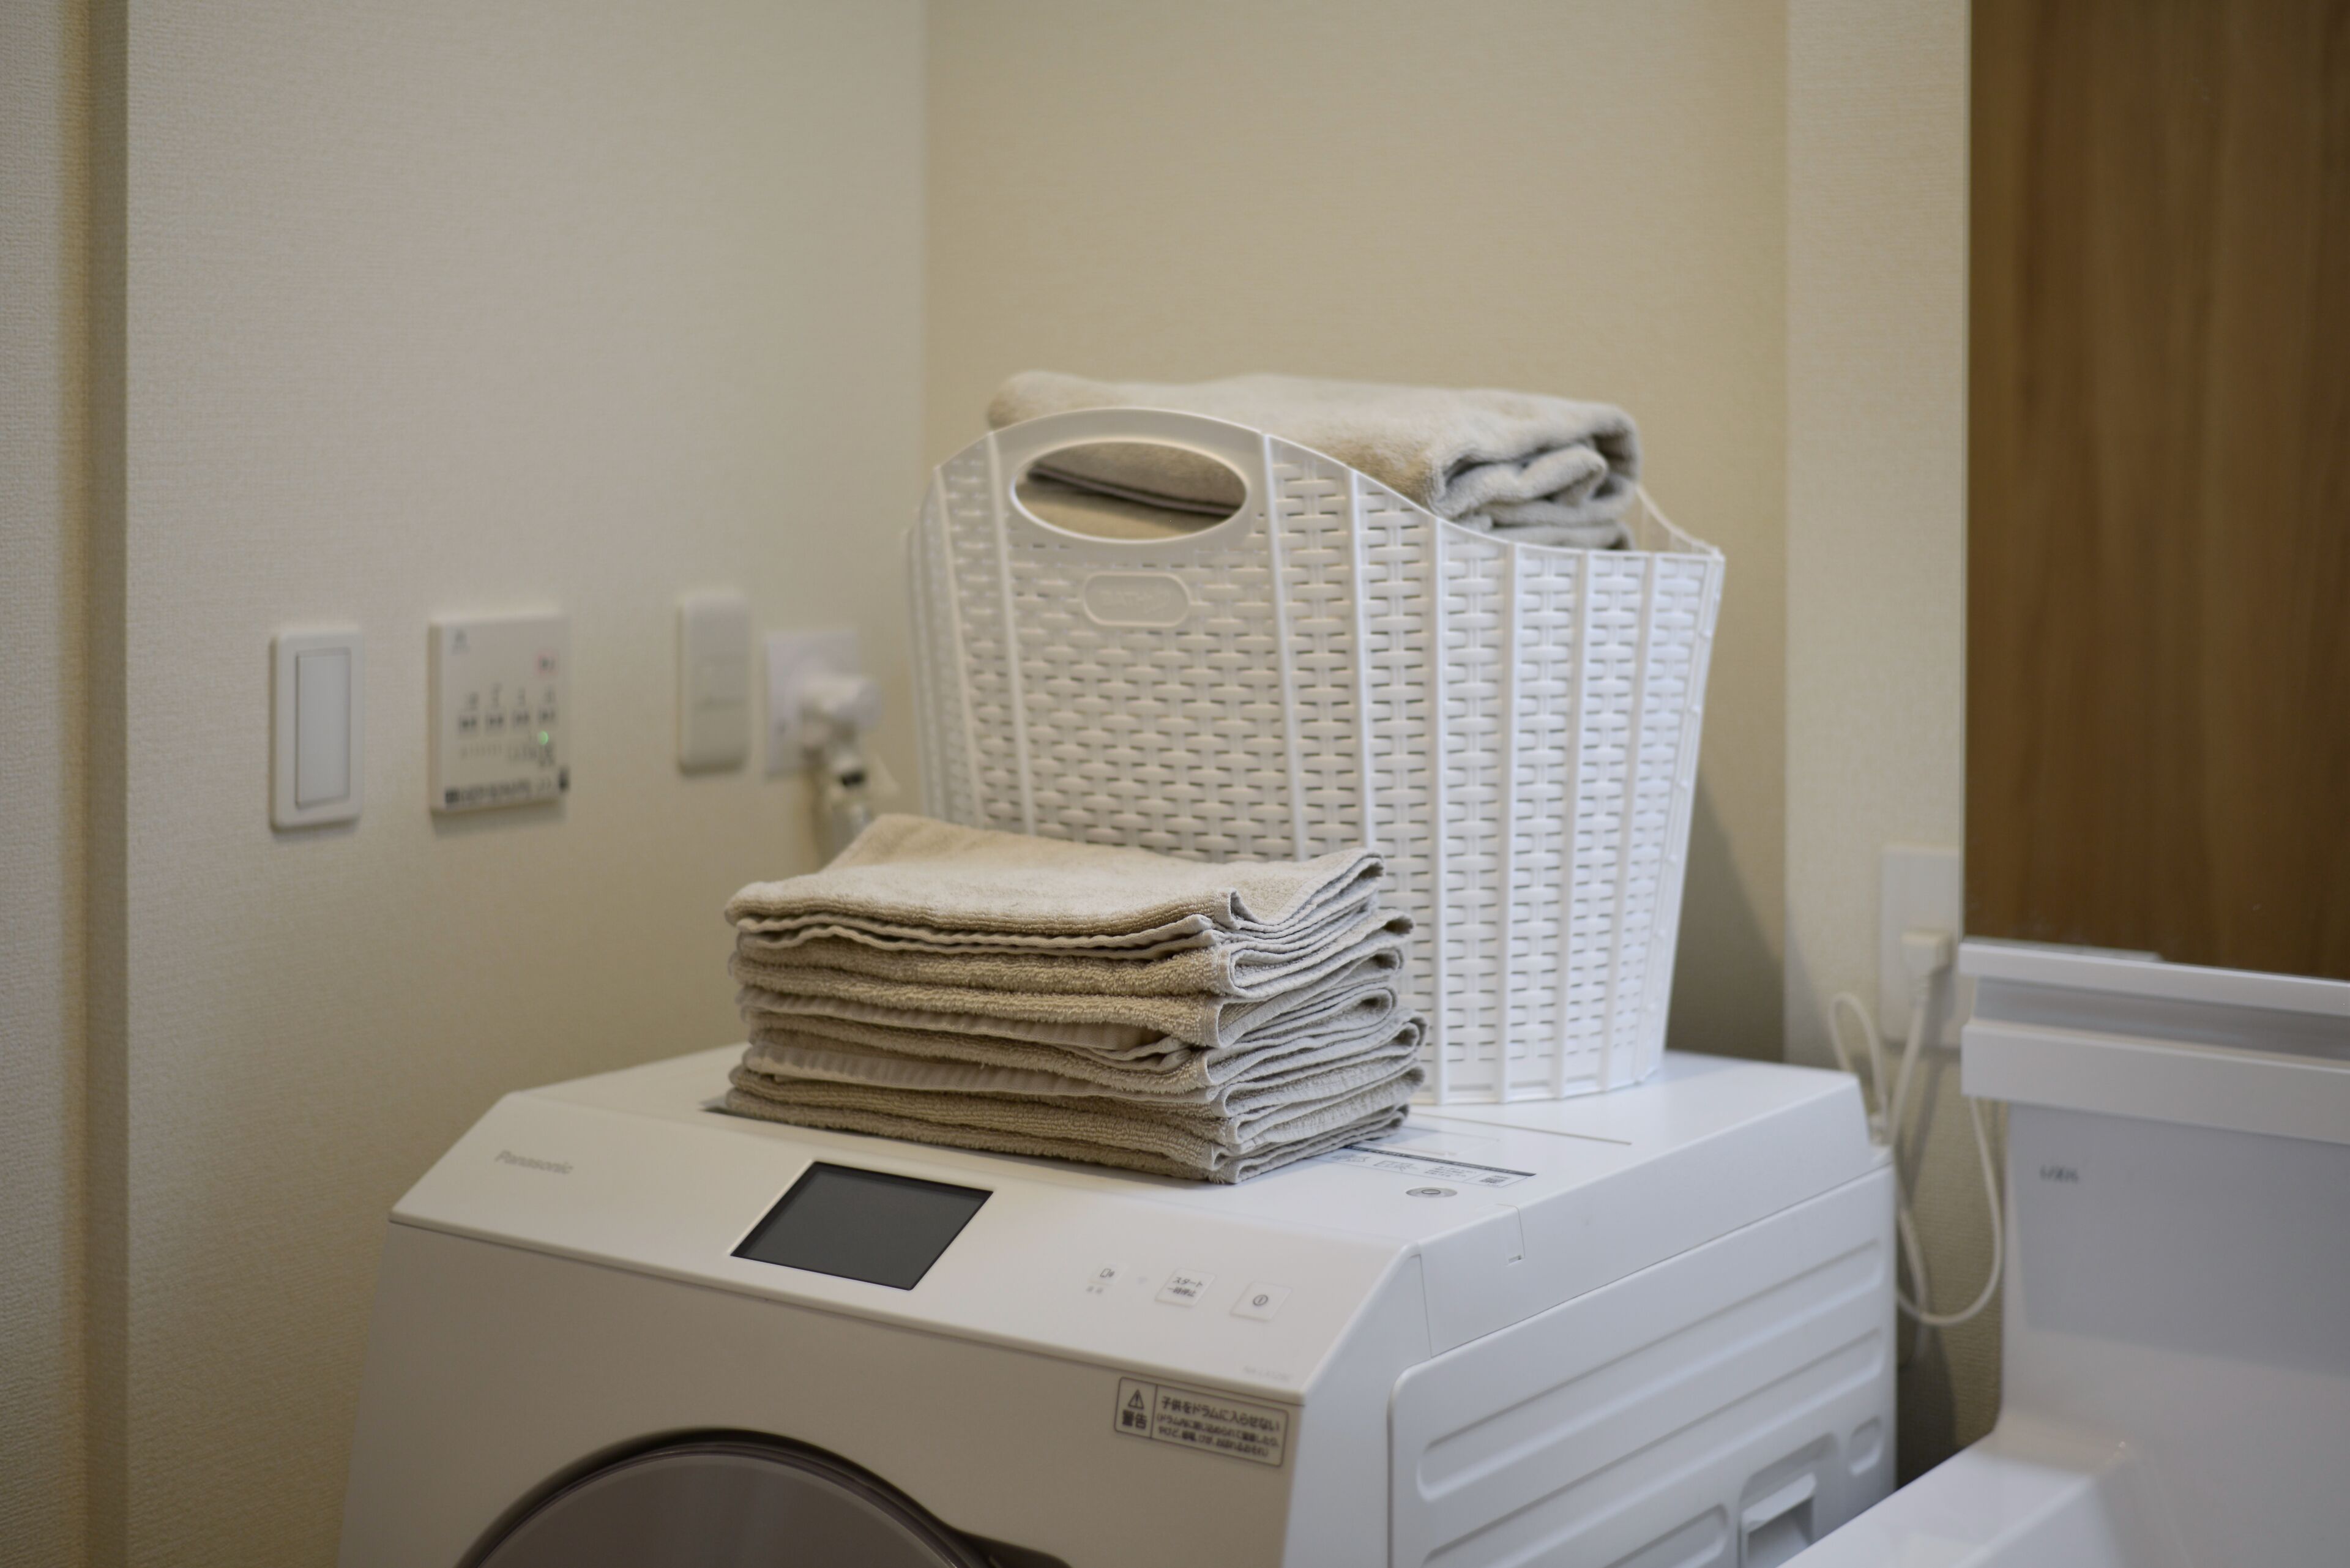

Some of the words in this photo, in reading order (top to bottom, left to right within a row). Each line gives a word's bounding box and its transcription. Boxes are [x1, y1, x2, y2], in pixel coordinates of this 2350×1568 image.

[494, 1149, 574, 1174] Panasonic
[1172, 1276, 1203, 1288] スタート
[1122, 1409, 1148, 1430] 警告
[1161, 1395, 1280, 1432] 子供をドラムに入らせない
